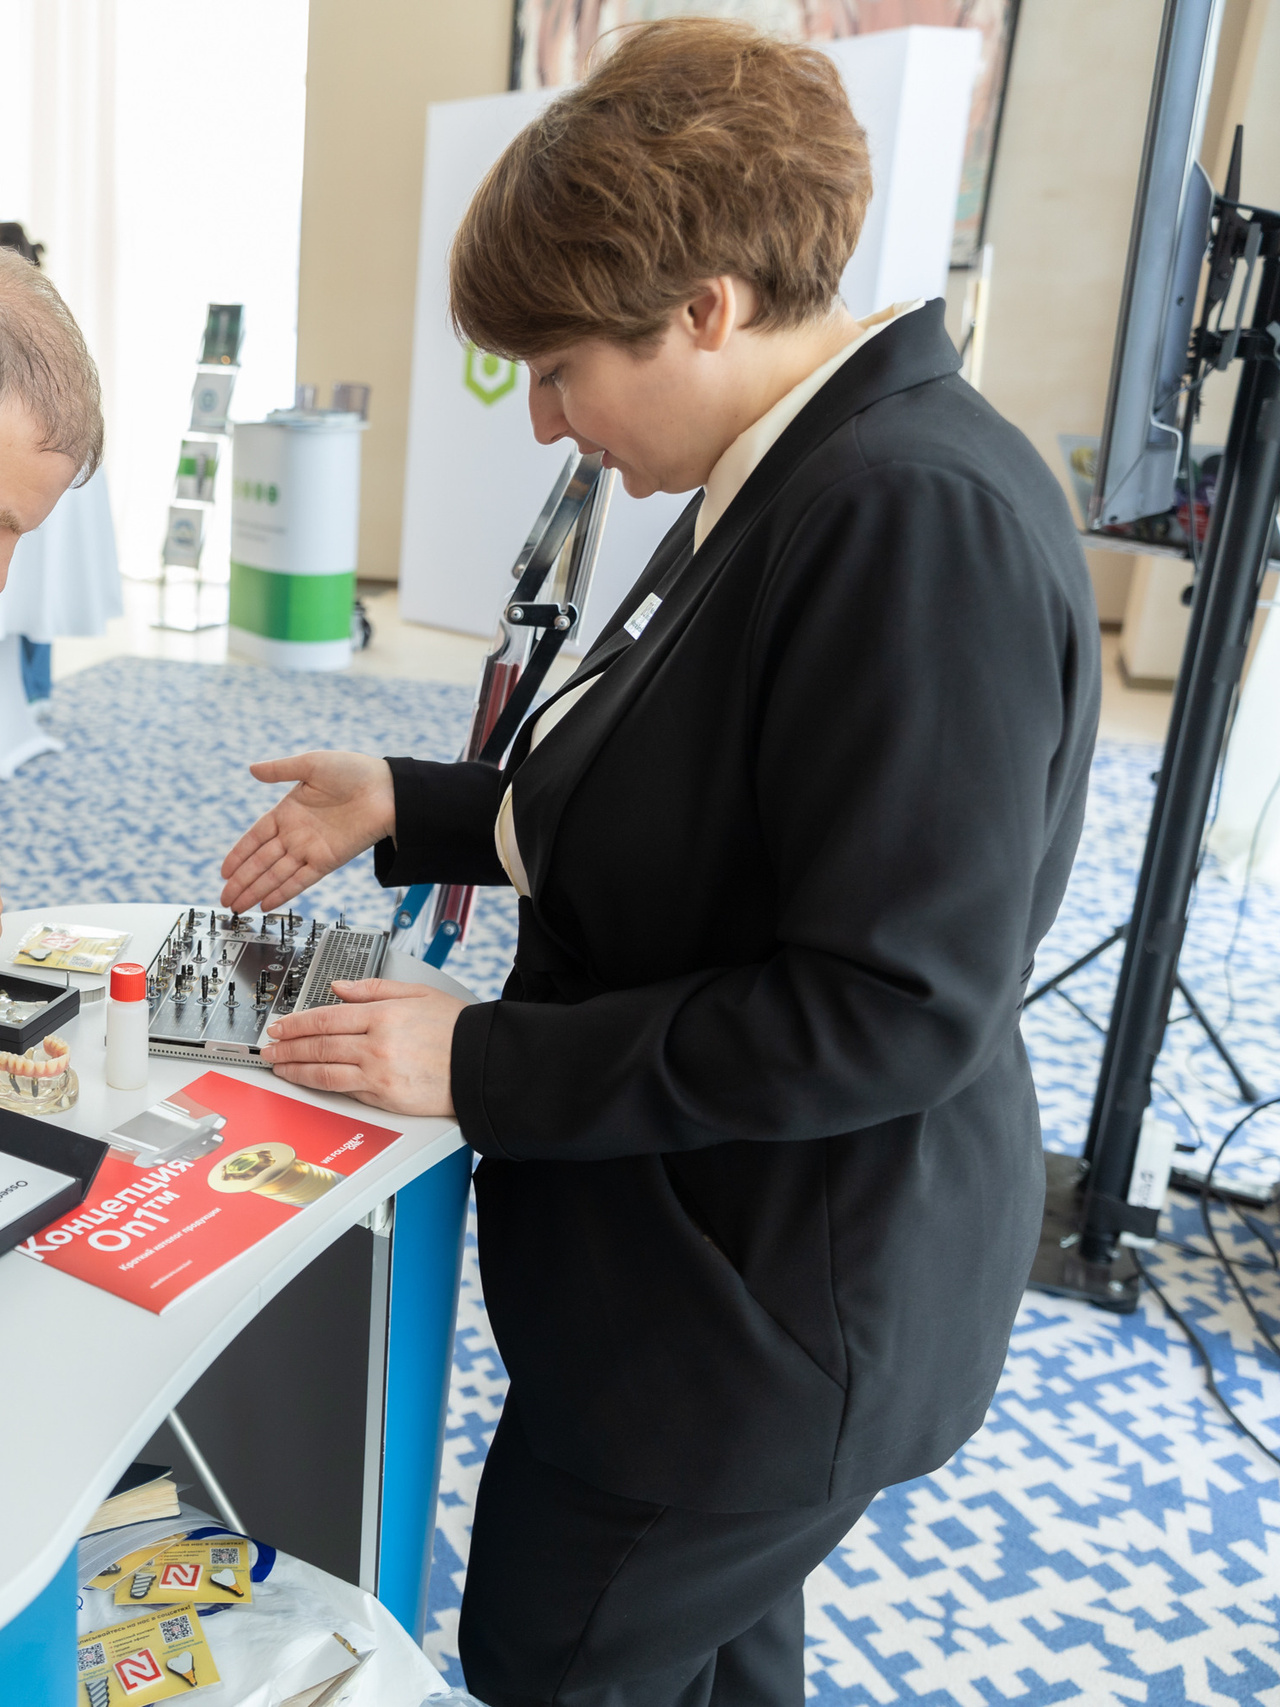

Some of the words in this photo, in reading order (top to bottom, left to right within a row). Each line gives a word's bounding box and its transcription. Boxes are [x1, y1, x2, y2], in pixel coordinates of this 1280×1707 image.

[320, 1155, 334, 1164] WE
[15, 1157, 196, 1261] Концепция
[117, 1248, 155, 1271] Краткий
[153, 1230, 183, 1251] каталог
[181, 1207, 221, 1231] продукции
